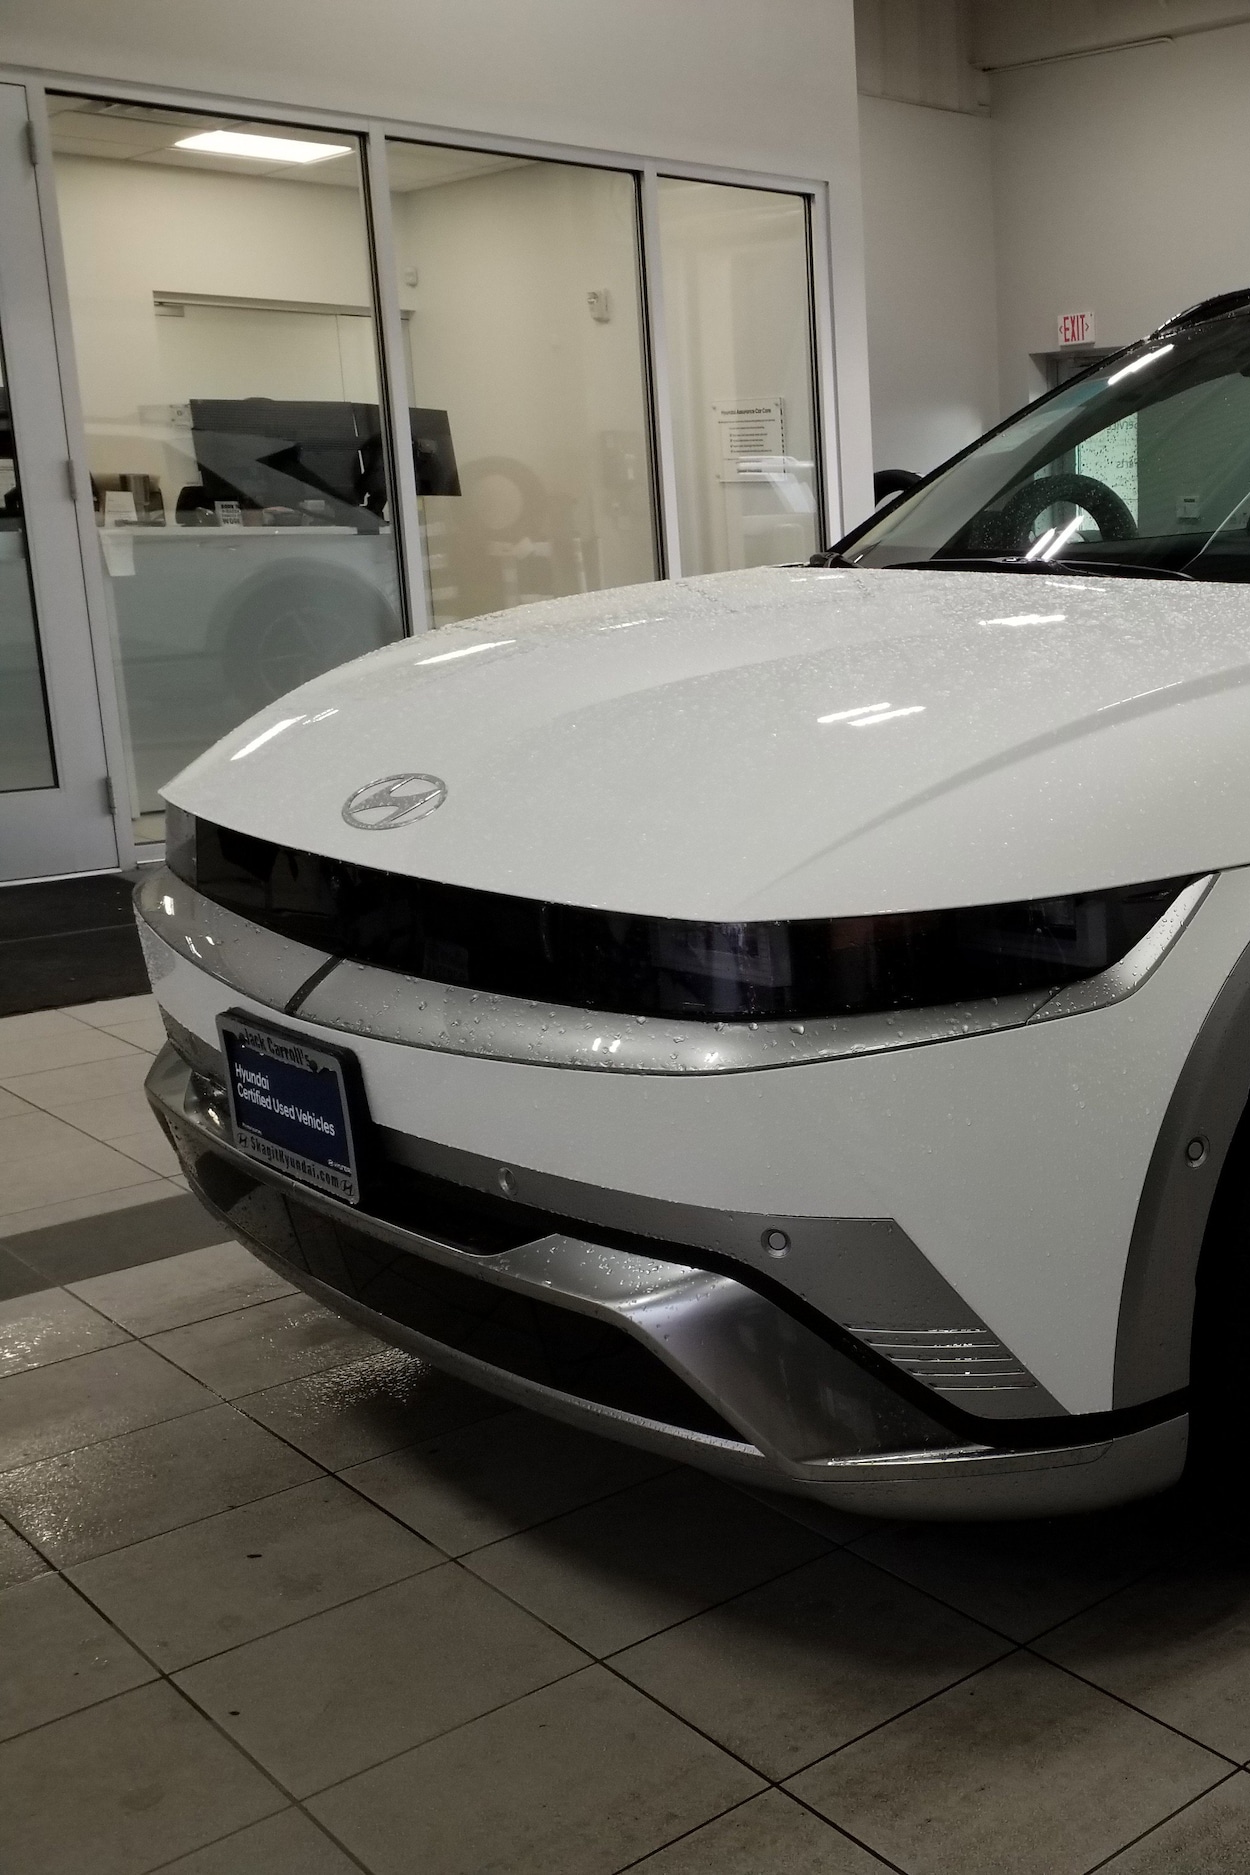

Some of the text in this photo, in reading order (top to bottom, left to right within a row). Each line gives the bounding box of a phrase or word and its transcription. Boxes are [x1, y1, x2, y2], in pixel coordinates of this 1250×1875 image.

[1063, 314, 1085, 342] EXIT
[242, 1028, 312, 1067] Jack Carroll's
[234, 1061, 270, 1091] Hyundai
[236, 1082, 272, 1111] Certified
[271, 1099, 296, 1121] Used
[295, 1106, 336, 1137] Vehicles
[250, 1135, 340, 1188] SkagitHyundai.com
